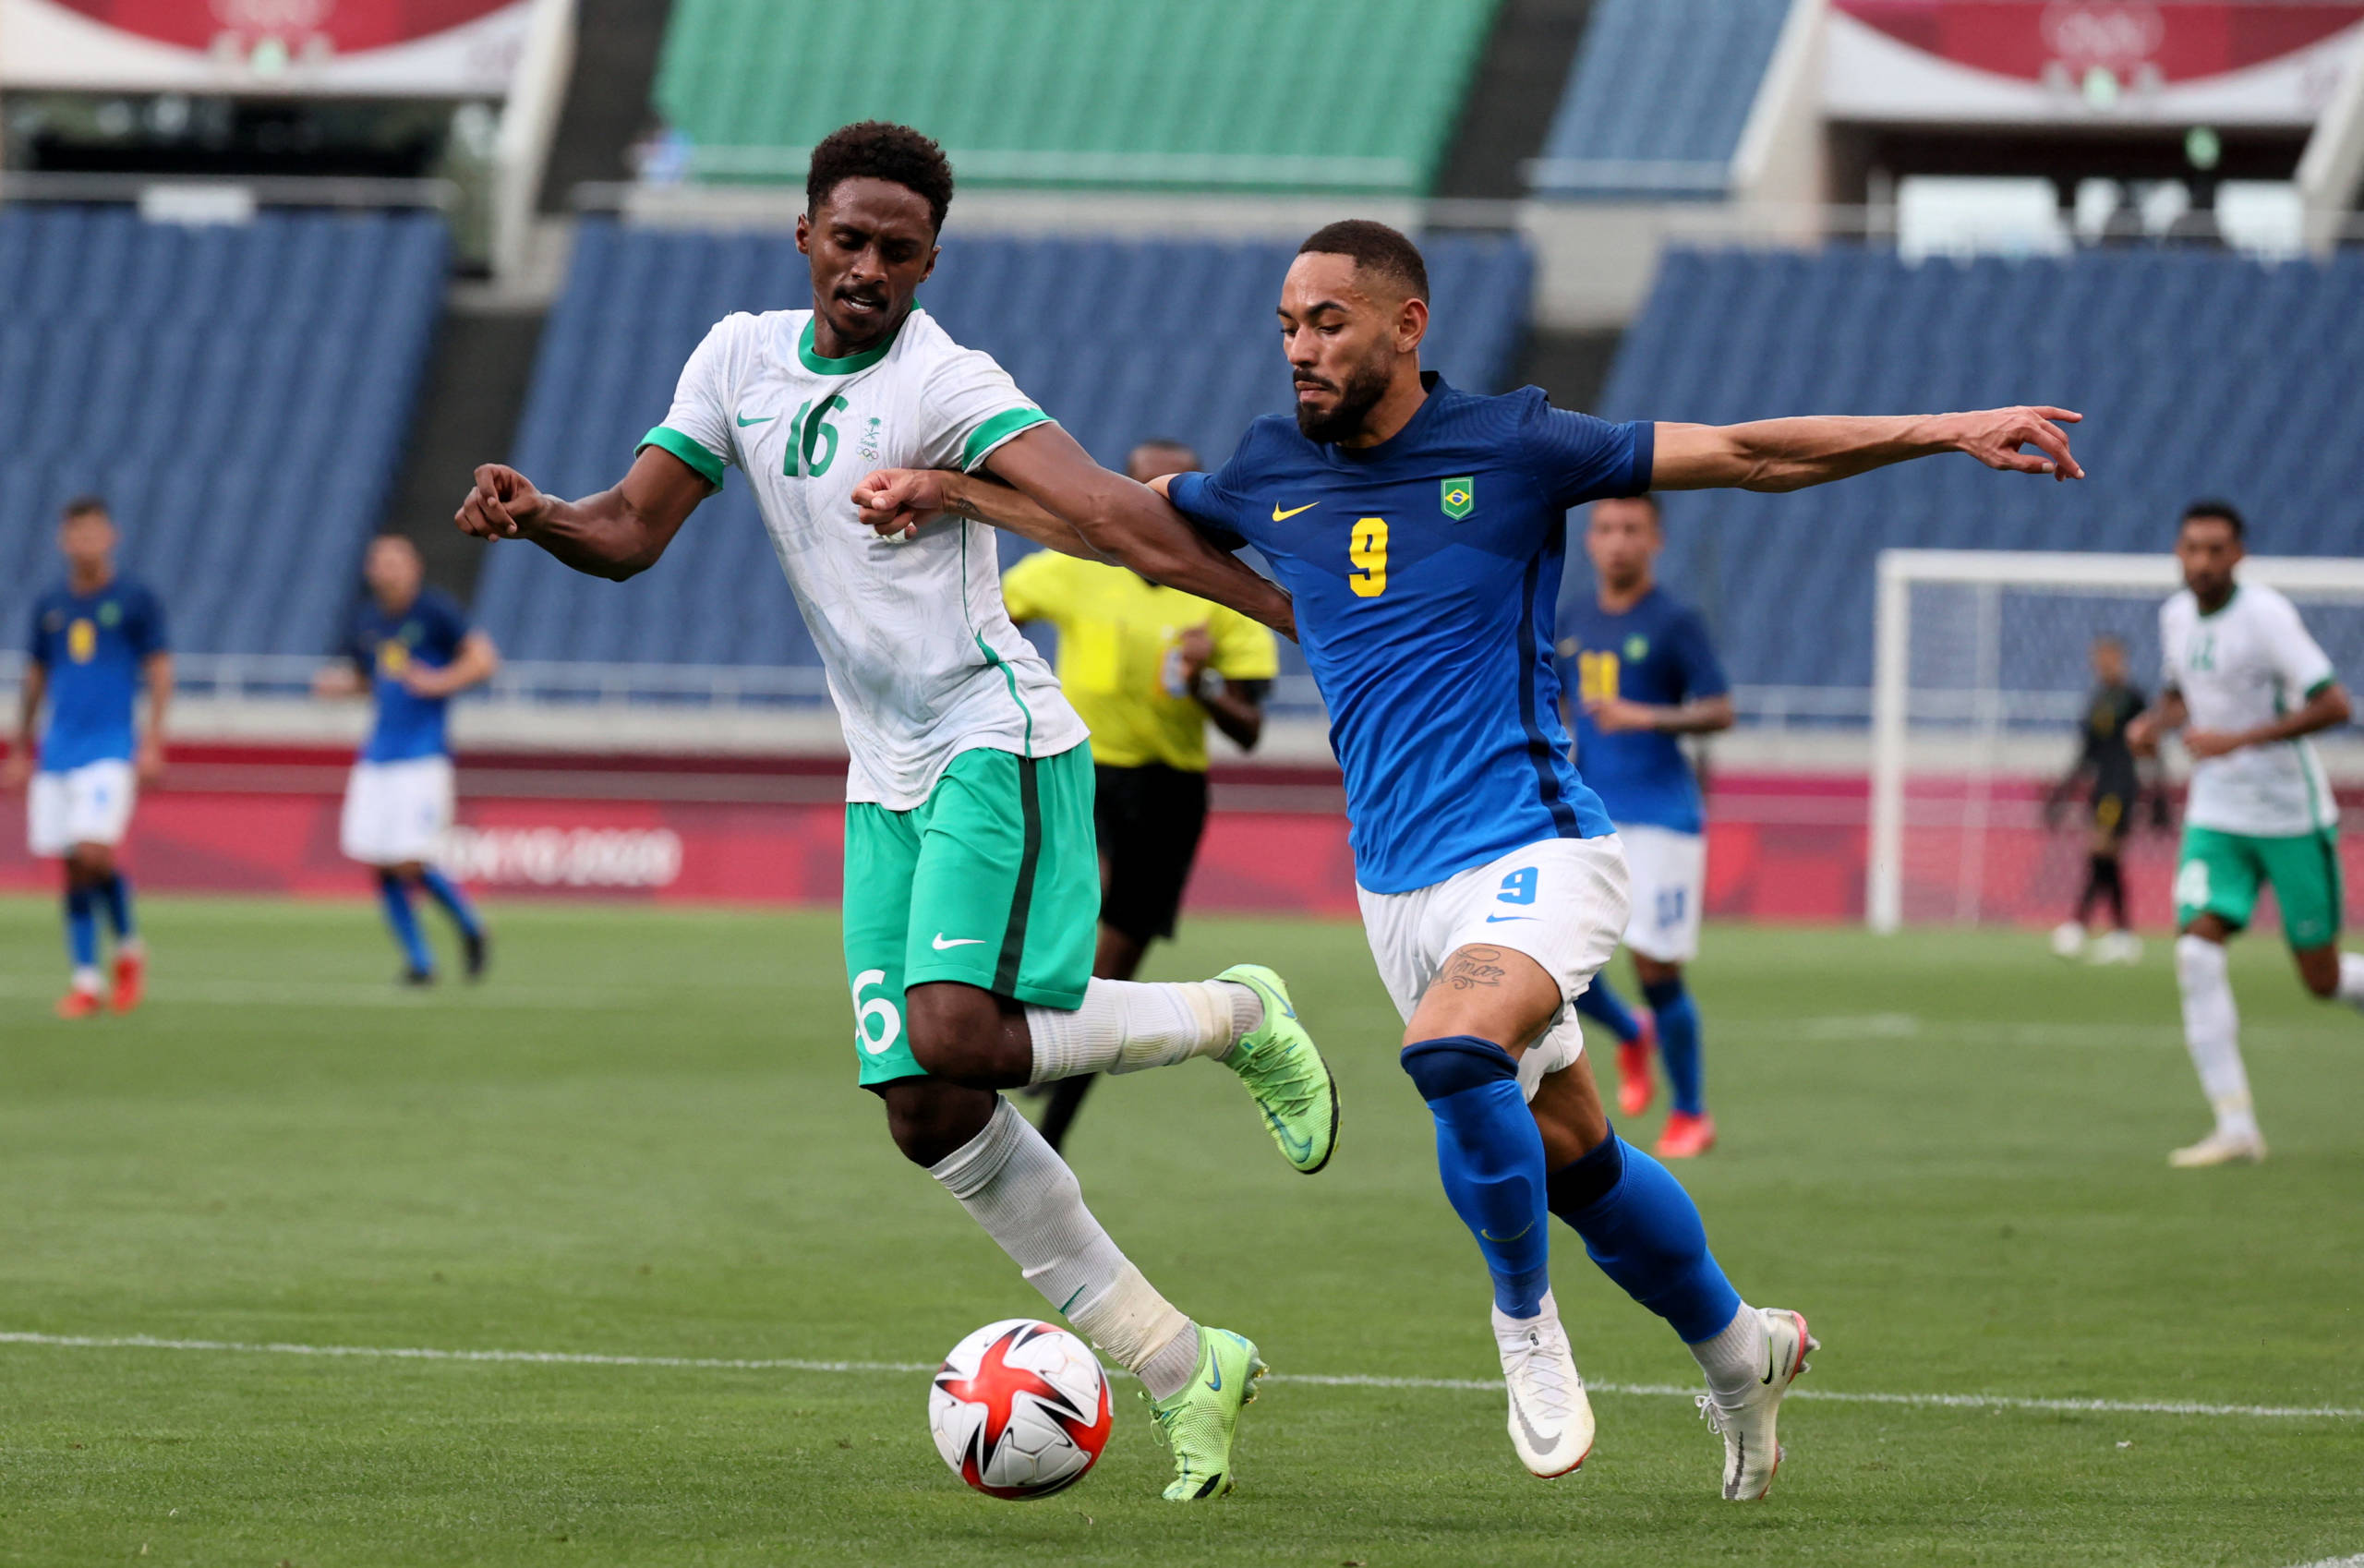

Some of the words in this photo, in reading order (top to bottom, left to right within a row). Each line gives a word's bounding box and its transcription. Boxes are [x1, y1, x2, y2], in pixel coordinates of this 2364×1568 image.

[783, 394, 849, 477] 16
[1348, 517, 1389, 597] 9
[1496, 866, 1538, 906] 9
[852, 969, 901, 1055] 6
